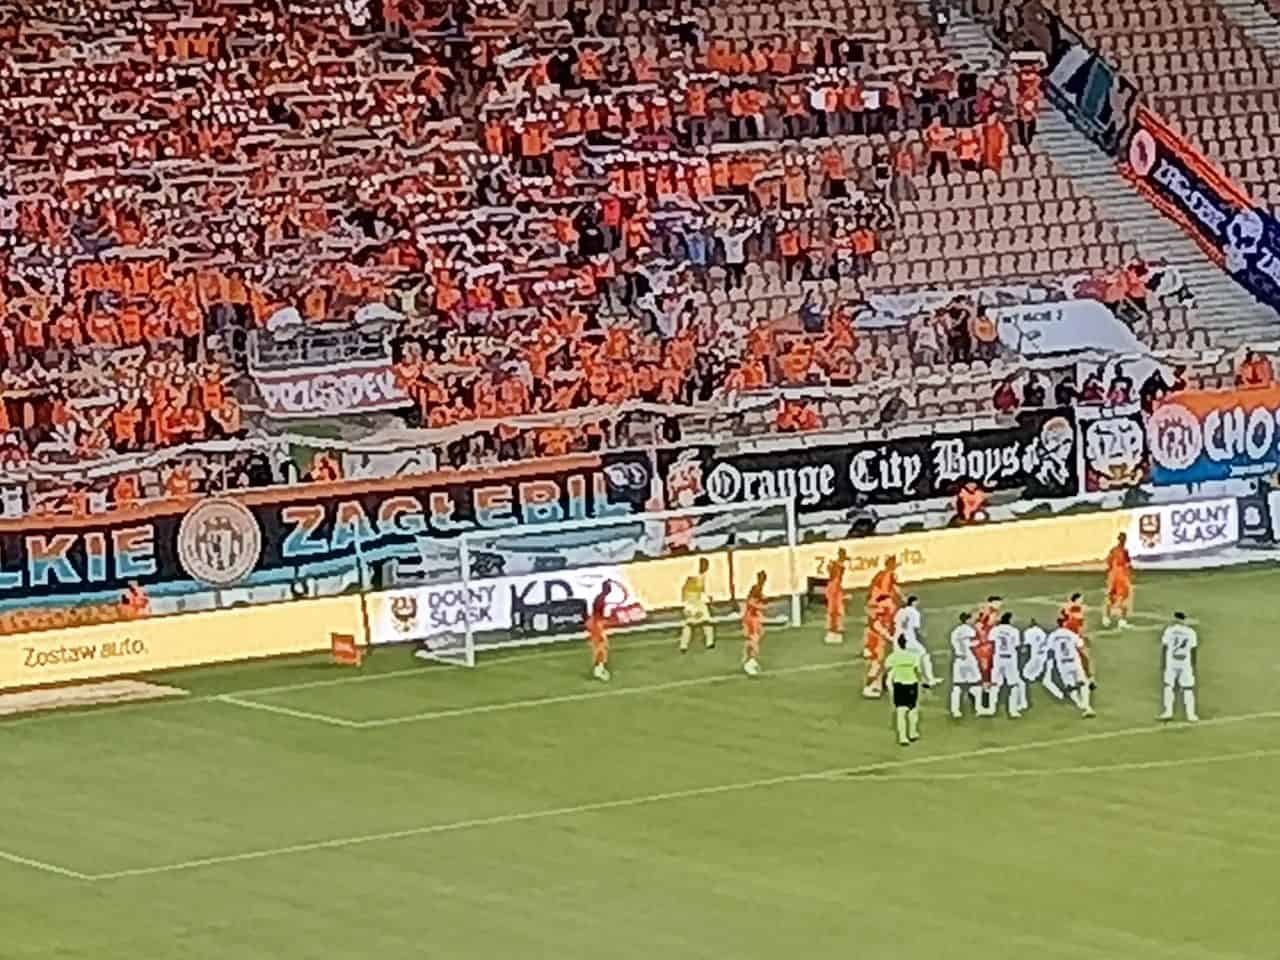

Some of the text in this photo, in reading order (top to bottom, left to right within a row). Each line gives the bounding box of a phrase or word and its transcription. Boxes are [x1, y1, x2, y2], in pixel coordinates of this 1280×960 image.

[706, 462, 835, 505] Orange
[849, 447, 922, 495] City
[931, 439, 1020, 488] Boys
[1171, 504, 1230, 527] DOLNY
[429, 584, 496, 609] DOLNY
[23, 643, 97, 667] Zostaw
